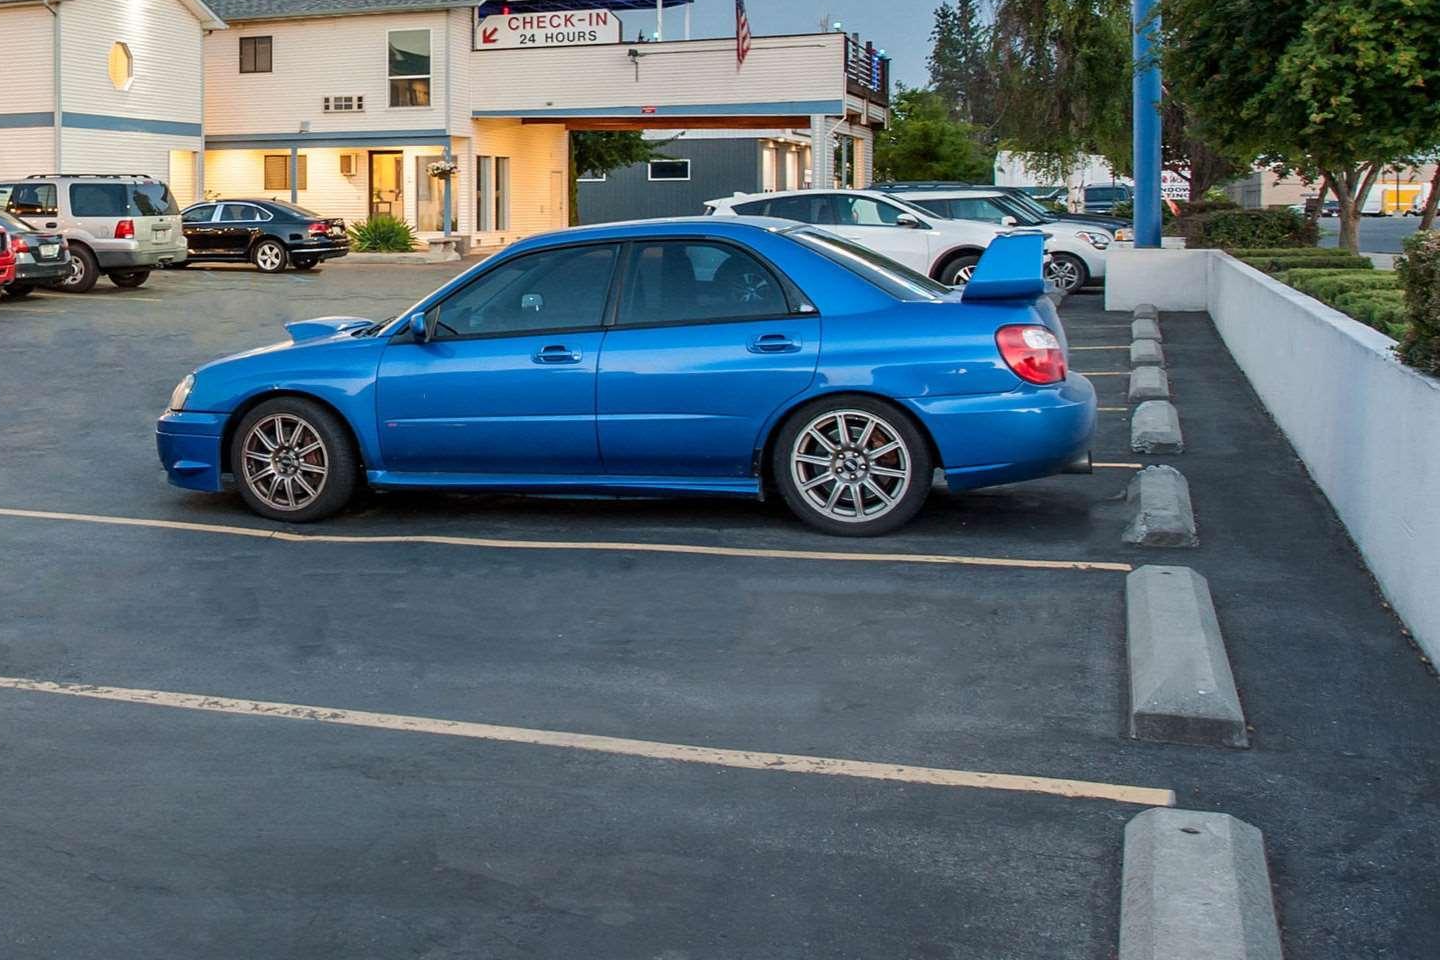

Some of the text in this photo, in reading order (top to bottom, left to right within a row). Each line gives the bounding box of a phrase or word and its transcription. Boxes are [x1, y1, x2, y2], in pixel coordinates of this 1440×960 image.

[508, 12, 608, 30] CHECK-IN
[519, 30, 597, 44] 24 HOURS
